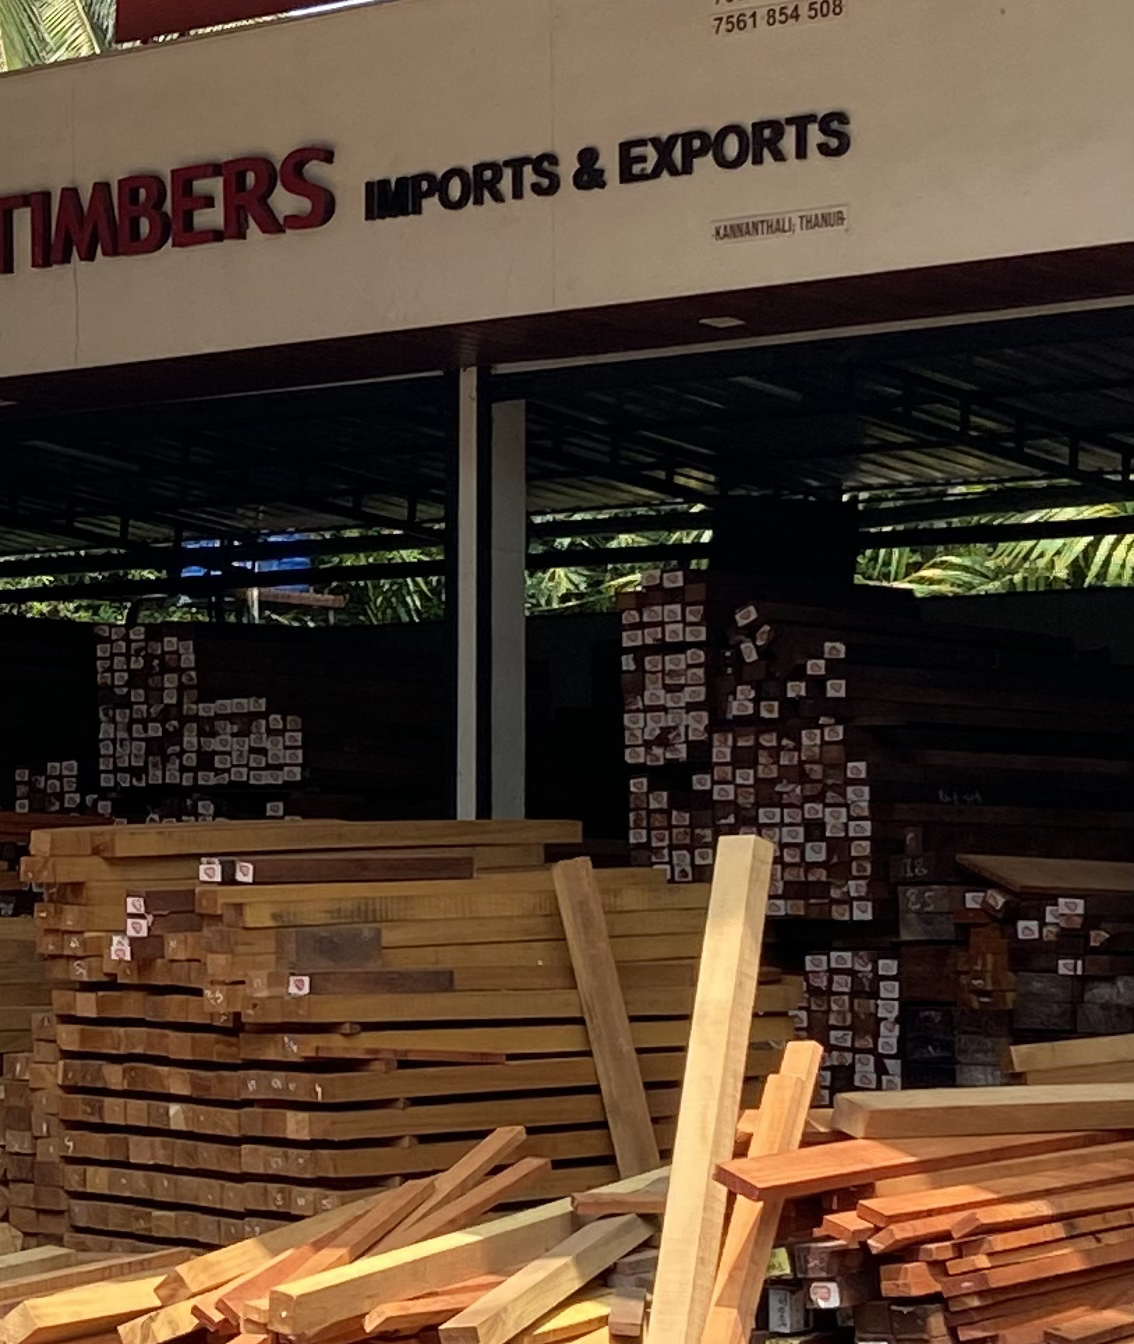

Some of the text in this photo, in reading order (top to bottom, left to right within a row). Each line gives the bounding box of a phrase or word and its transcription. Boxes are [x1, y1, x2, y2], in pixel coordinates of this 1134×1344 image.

[713, 11, 757, 35] 7561
[766, 4, 801, 27] 854
[364, 153, 561, 221] IMPORTS
[572, 147, 607, 191] &
[618, 111, 852, 184] EXPORTS
